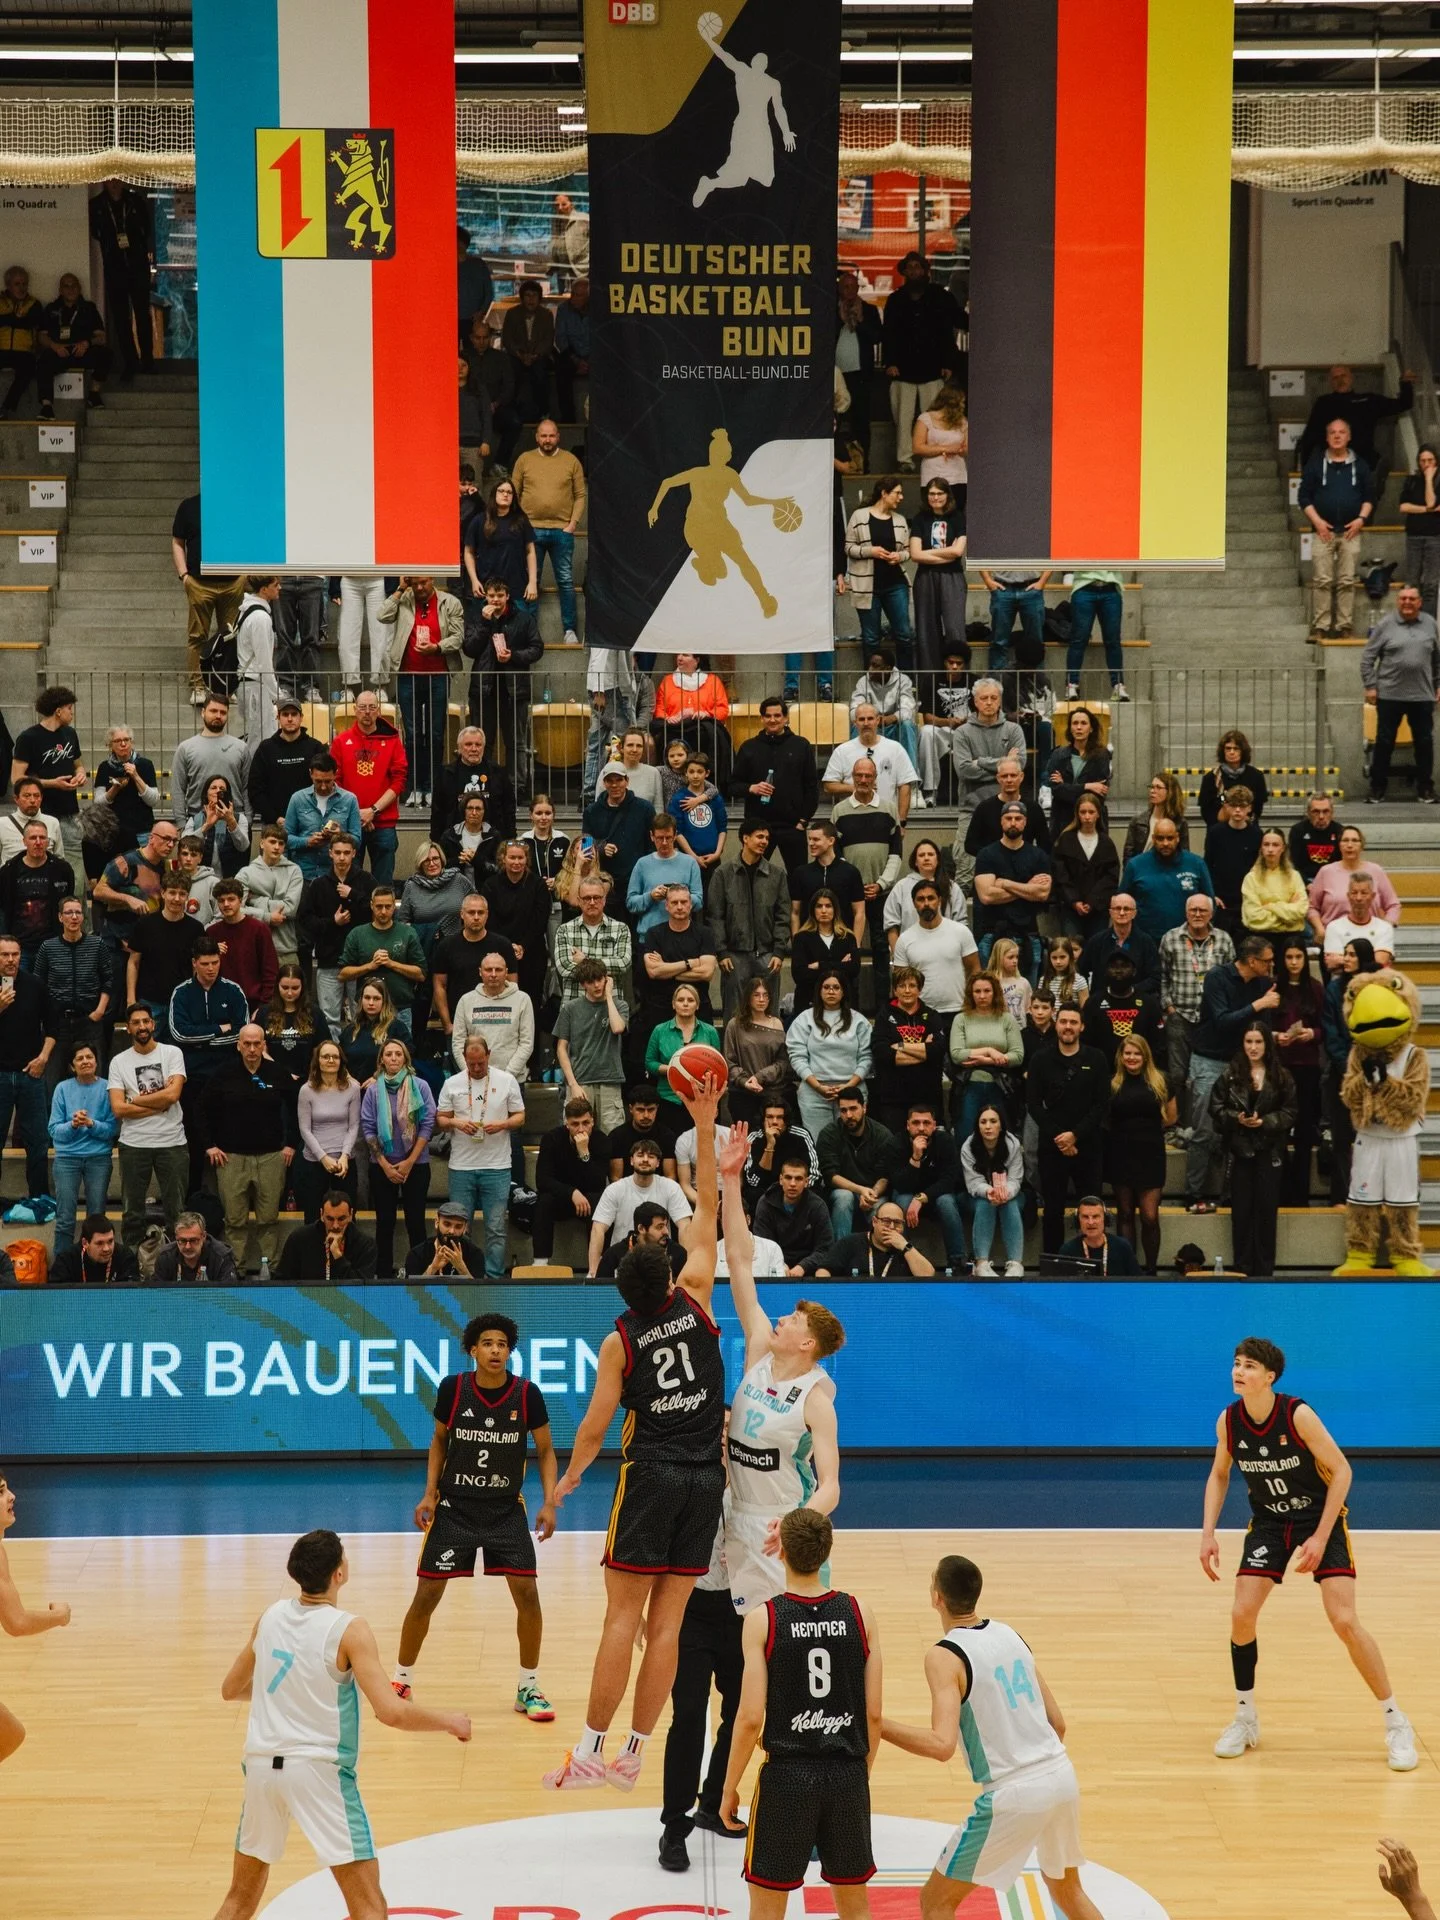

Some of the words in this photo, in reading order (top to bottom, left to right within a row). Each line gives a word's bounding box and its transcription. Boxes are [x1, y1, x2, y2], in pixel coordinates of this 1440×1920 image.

[612, 2, 656, 22] DBB
[3, 200, 15, 208] im
[17, 200, 57, 209] Quadrat
[1292, 198, 1318, 208] Sport
[1320, 197, 1333, 206] im
[1335, 197, 1374, 207] Quadrat
[621, 242, 812, 275] DEUTSCHER
[609, 284, 811, 315] BASKETBALL
[722, 325, 811, 356] BUND
[662, 365, 811, 379] BASKETBALL-BUND.DE
[58, 384, 72, 392] VIP
[1280, 381, 1294, 389] VIP
[50, 437, 63, 445] VIP
[41, 492, 54, 500] VIP
[31, 547, 44, 556] VIP
[42, 1343, 183, 1398] WIR
[205, 1338, 449, 1397] BAUEN
[473, 1337, 602, 1394] EN
[652, 1342, 696, 1390] 21
[650, 1388, 708, 1414] Kellogg's
[743, 1407, 766, 1439] 12
[456, 1428, 519, 1444] DEUTSCHLAND
[477, 1450, 490, 1468] 2
[1238, 1455, 1300, 1473] DEUTSCHLAND
[454, 1473, 487, 1487] ING
[1264, 1478, 1289, 1496] 10
[791, 1620, 847, 1638] KEMMER
[267, 1648, 295, 1694] 7
[808, 1647, 831, 1698] 8
[994, 1659, 1035, 1709] 14
[791, 1709, 854, 1735] Kellogg's
